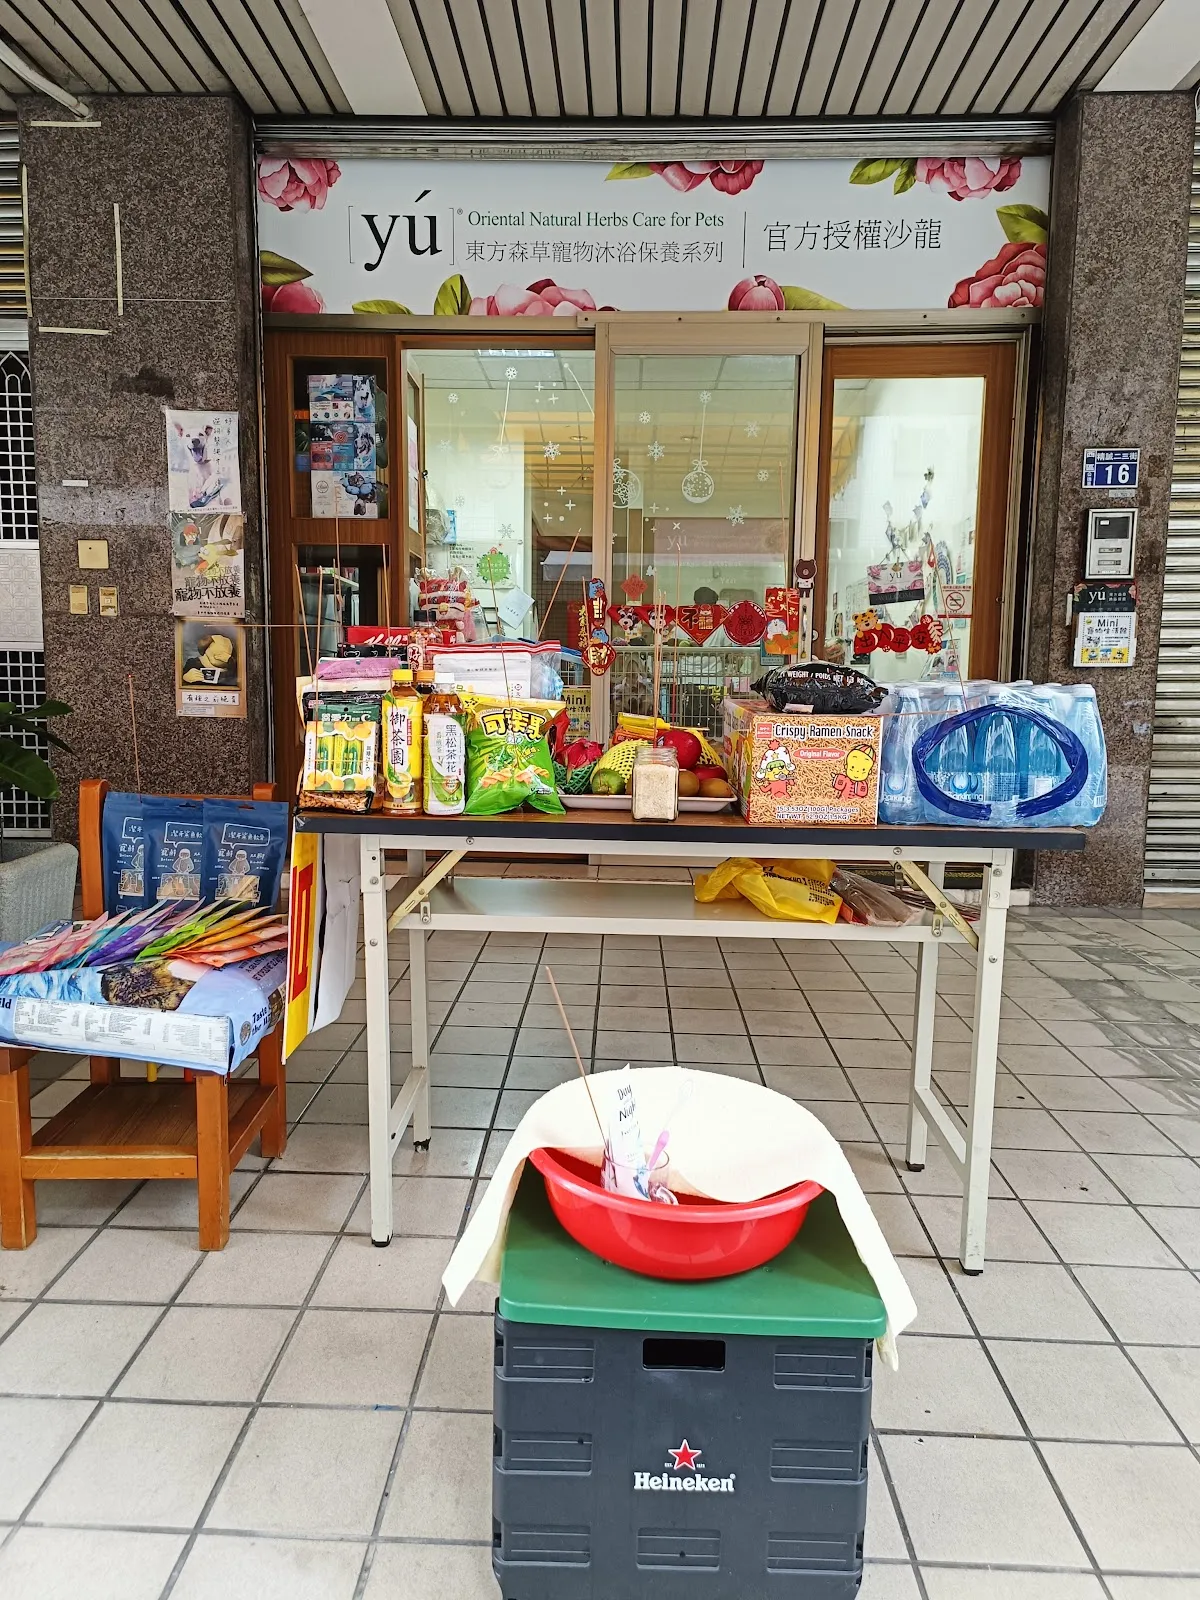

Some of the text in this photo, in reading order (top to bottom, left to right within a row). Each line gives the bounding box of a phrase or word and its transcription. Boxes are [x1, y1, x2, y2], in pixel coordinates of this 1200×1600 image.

[467, 210, 724, 227] Oriental Natural Herbs Care for Pets
[763, 218, 942, 252] 官方授權沙龍
[465, 240, 724, 264] 東方森草寵物沐浴保養系列
[1104, 464, 1130, 485] 16
[1088, 586, 1106, 604] yú
[1097, 618, 1119, 628] Mini
[787, 670, 809, 679] WEIGHT
[815, 672, 831, 681] POIDS
[389, 711, 406, 766] 御茶園
[775, 724, 807, 740] Crispy
[809, 726, 842, 738] Ramen
[845, 725, 874, 738] Snack
[445, 724, 458, 773] 黑松茶花
[799, 749, 841, 759] Original Flavor
[829, 806, 859, 814] Packages
[252, 1006, 268, 1024] Taste
[633, 1471, 736, 1492] Heineken
